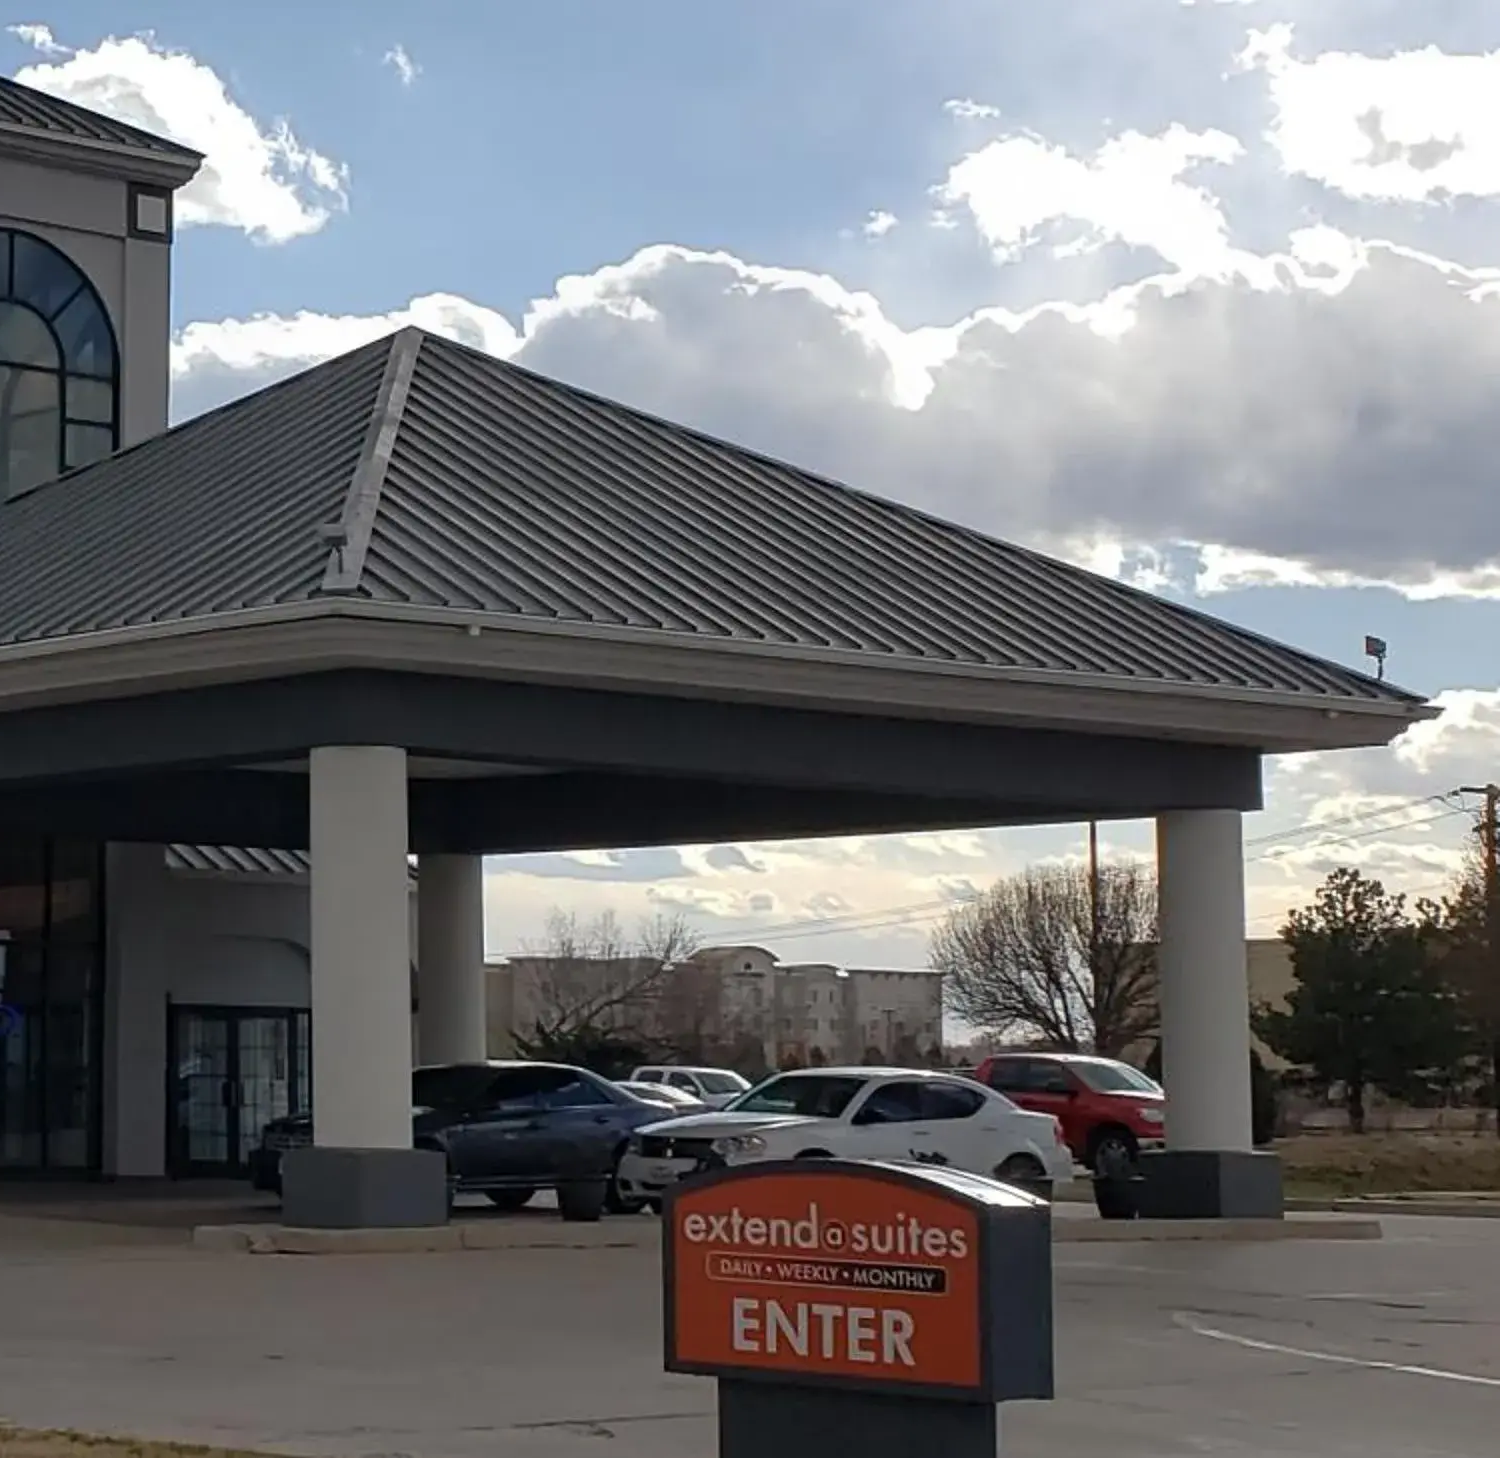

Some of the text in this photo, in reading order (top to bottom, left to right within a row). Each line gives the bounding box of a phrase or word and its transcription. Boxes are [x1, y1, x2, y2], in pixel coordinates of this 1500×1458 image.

[720, 1259, 935, 1289] DAILY WEEKLY MONTHLY
[733, 1297, 916, 1366] ENTER
